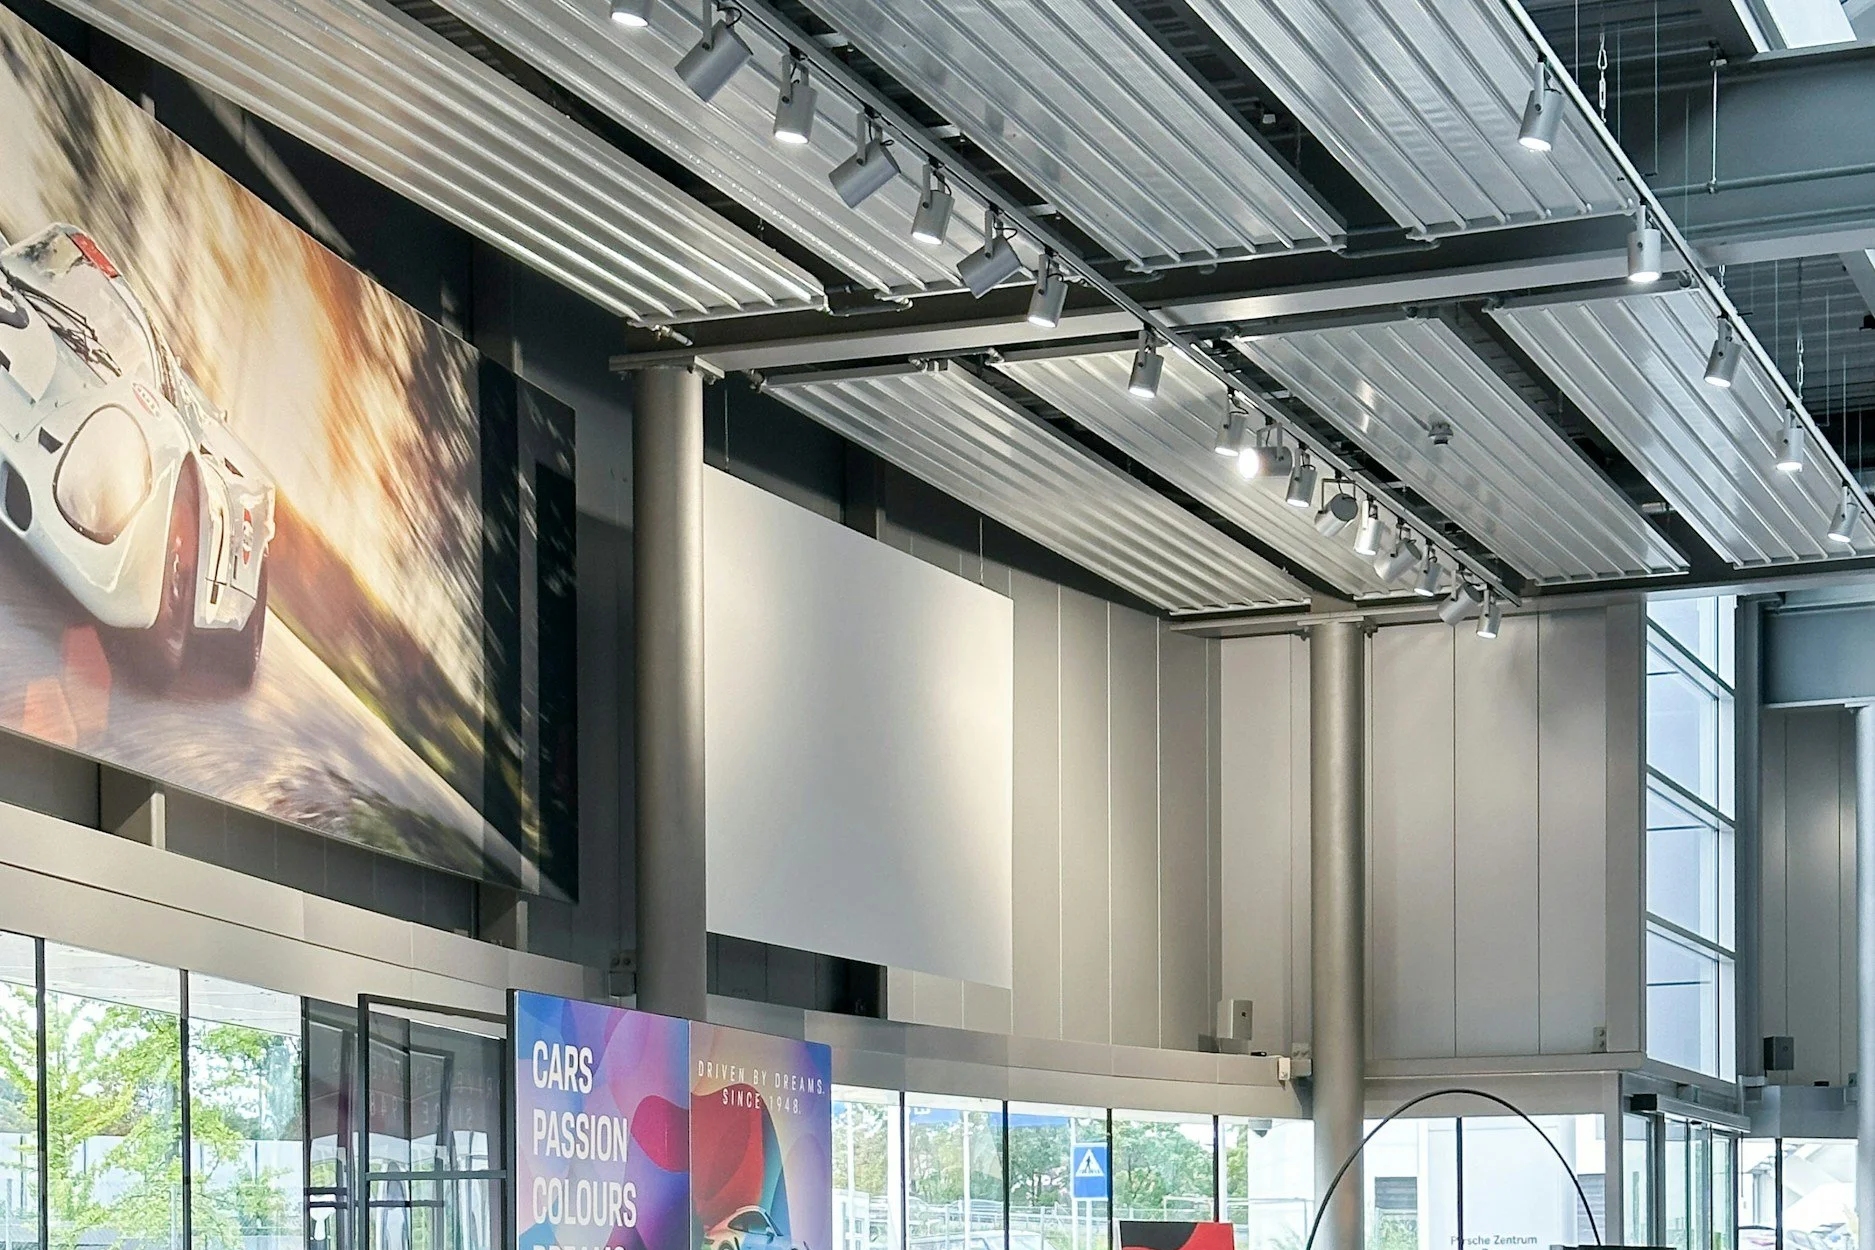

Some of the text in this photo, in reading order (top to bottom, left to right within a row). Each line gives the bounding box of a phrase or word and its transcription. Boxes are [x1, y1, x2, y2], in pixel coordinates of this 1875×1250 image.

[532, 1040, 595, 1094] CARS
[698, 1060, 826, 1095] DRIVEN BY DREAMS.
[722, 1088, 802, 1115] SINCE 1948.
[532, 1109, 629, 1163] PASSION
[531, 1177, 638, 1228] COLOURS
[1450, 1235, 1538, 1246] Prsche Zentrum
